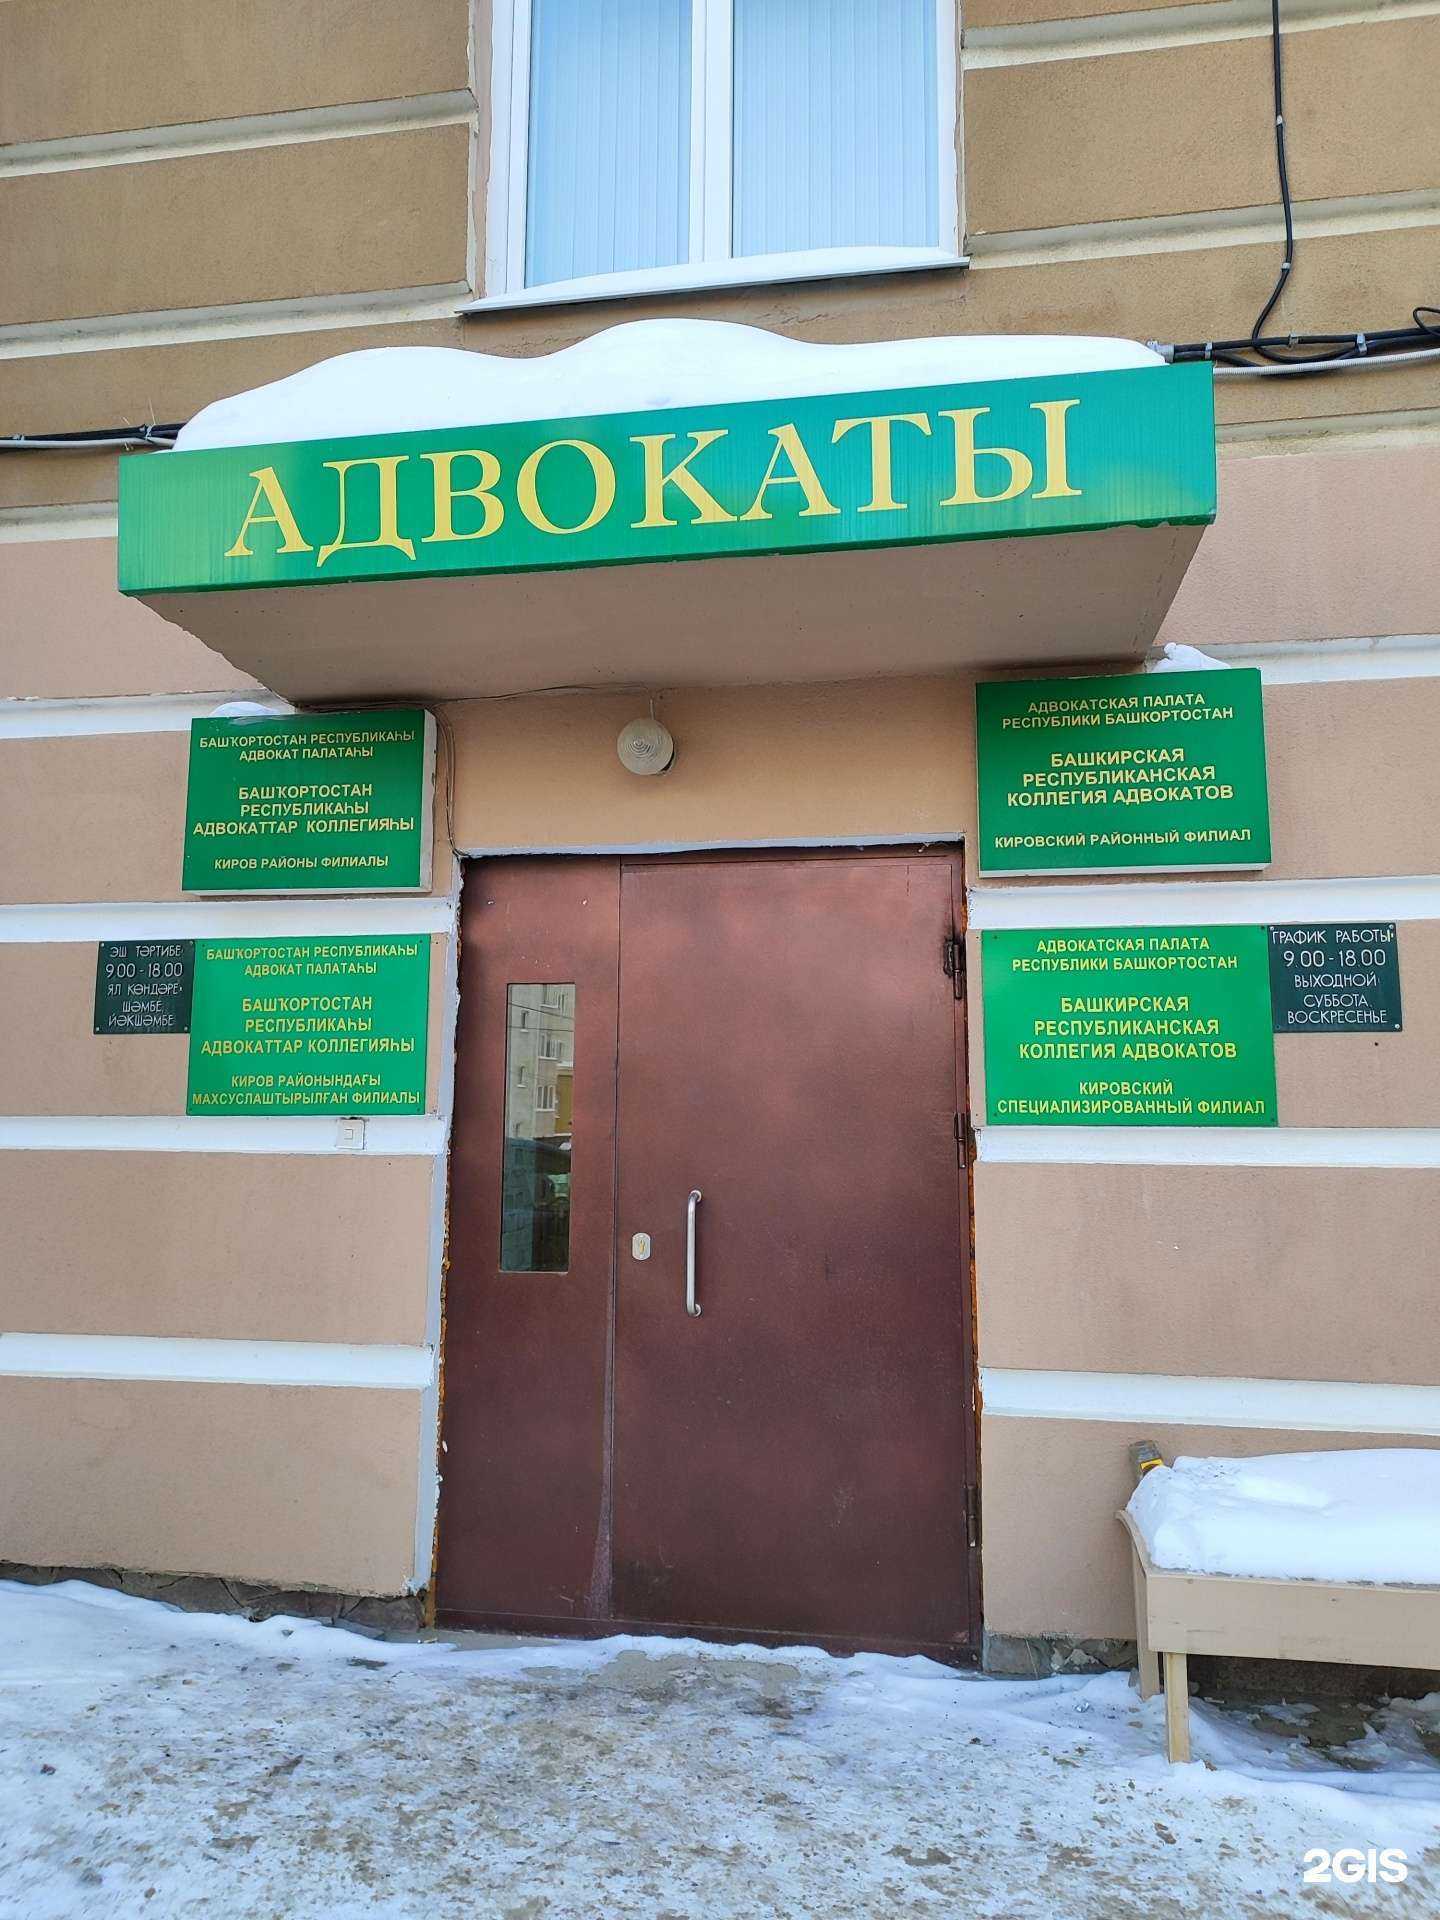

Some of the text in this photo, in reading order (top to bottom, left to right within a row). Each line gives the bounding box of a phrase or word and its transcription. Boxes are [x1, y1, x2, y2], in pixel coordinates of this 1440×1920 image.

[224, 399, 1082, 568] АДВОКАТЫ
[1028, 693, 1205, 715] АДВОКАТСКАЯ ПАЛАТА
[1002, 708, 1233, 729] РЕСПУБЛИКИ БАШКОРТОСТАН
[239, 750, 298, 762] АДВОКАТ
[1051, 748, 1184, 767] БАШКИРСКАЯ
[1023, 766, 1215, 787] РЕСПУБЛИКАНСКАЯ
[1008, 785, 1233, 806] КОЛЛЕГИЯ АДВОКАТОВ
[193, 821, 297, 836] АДВОКАТТАР
[995, 829, 1250, 848] КИРОВСКИЙ РАЙОННЫЙ ФИЛИАЛ
[214, 856, 388, 869] КИРОВ РАЙОНЫ ФИЛИАЛЫ
[1272, 930, 1327, 944] ГРАФИК
[110, 946, 127, 958] ЭШ
[1037, 937, 1210, 954] АДВОКАТСКАЯ ПАЛАТА
[244, 963, 302, 977] АДВОКАТ
[1012, 956, 1238, 972] РЕСПУБЛИКИ БАШКОРТОСТАН
[108, 984, 121, 995] ЯЛ
[1061, 996, 1189, 1013] БАШКИРСКАЯ
[1288, 1010, 1388, 1024] ВОСКРЕСЕНЬЕ
[1034, 1020, 1219, 1036] РЕСПУБЛИКАНСКАЯ
[201, 1039, 302, 1056] АДВОКАТТАР
[1020, 1042, 1237, 1061] КОЛЛЕГИЯ АДВОКАТОВ
[231, 1075, 273, 1088] КИРОВ
[1080, 1079, 1173, 1095] КИРОВСКИЙ
[352, 1091, 419, 1104] ФИЛИАЛЫ
[998, 1098, 1264, 1116] СПЕЦИАЛИЗИРОВАННЫЙ ФИЛИАЛ
